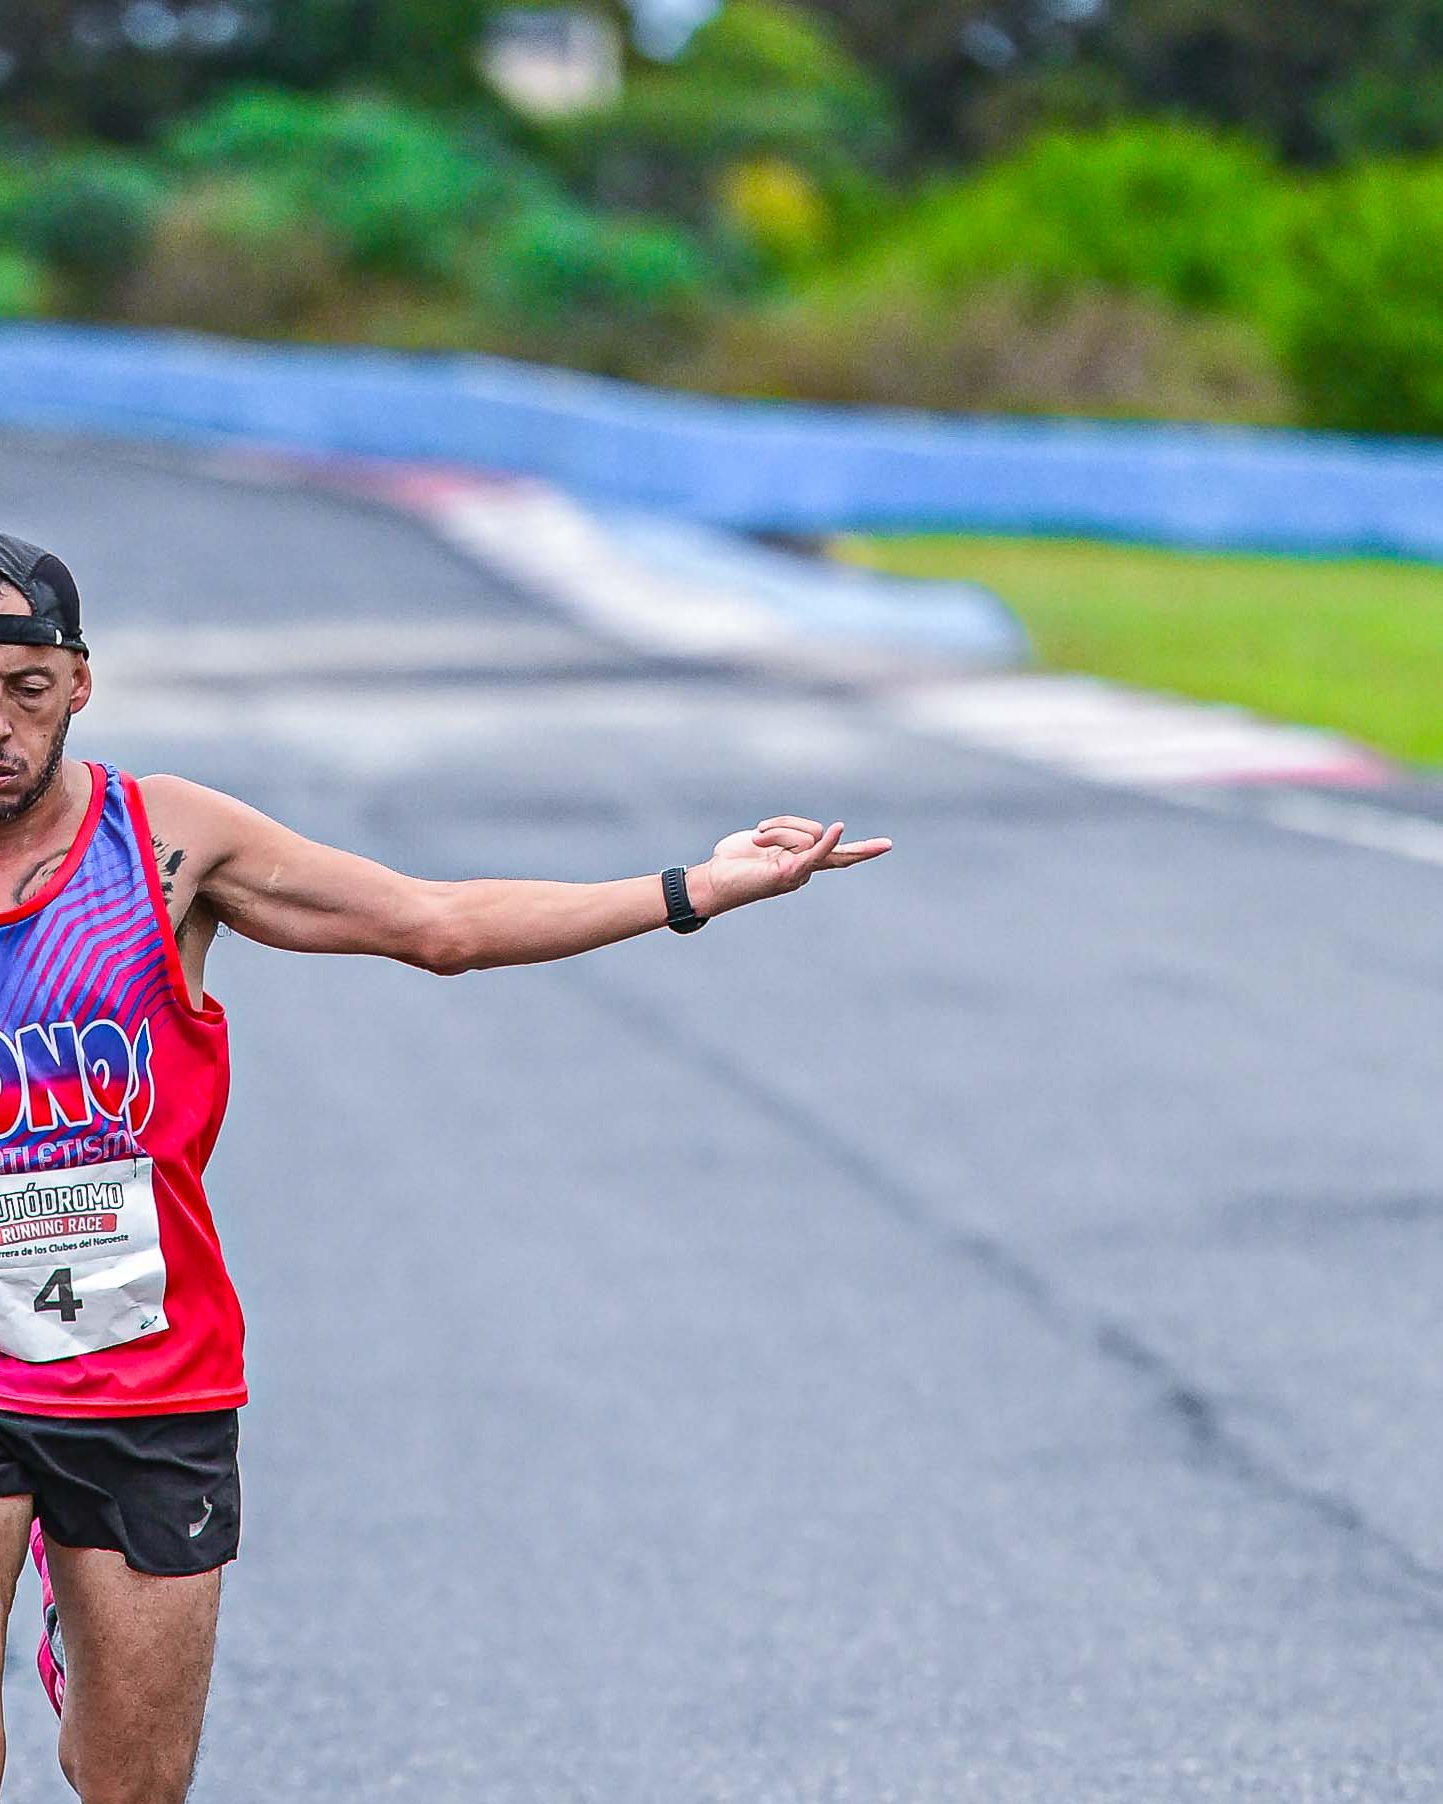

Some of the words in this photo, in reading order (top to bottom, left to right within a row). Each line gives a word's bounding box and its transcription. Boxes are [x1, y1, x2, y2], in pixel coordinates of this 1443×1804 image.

[1, 1219, 64, 1244] RUNNING
[68, 1216, 103, 1233] RACE
[21, 1247, 33, 1257] de
[34, 1245, 47, 1255] los
[48, 1243, 78, 1254] Clubes
[79, 1240, 92, 1250] del
[93, 1234, 129, 1245] Noroeste
[32, 1266, 83, 1323] 4
